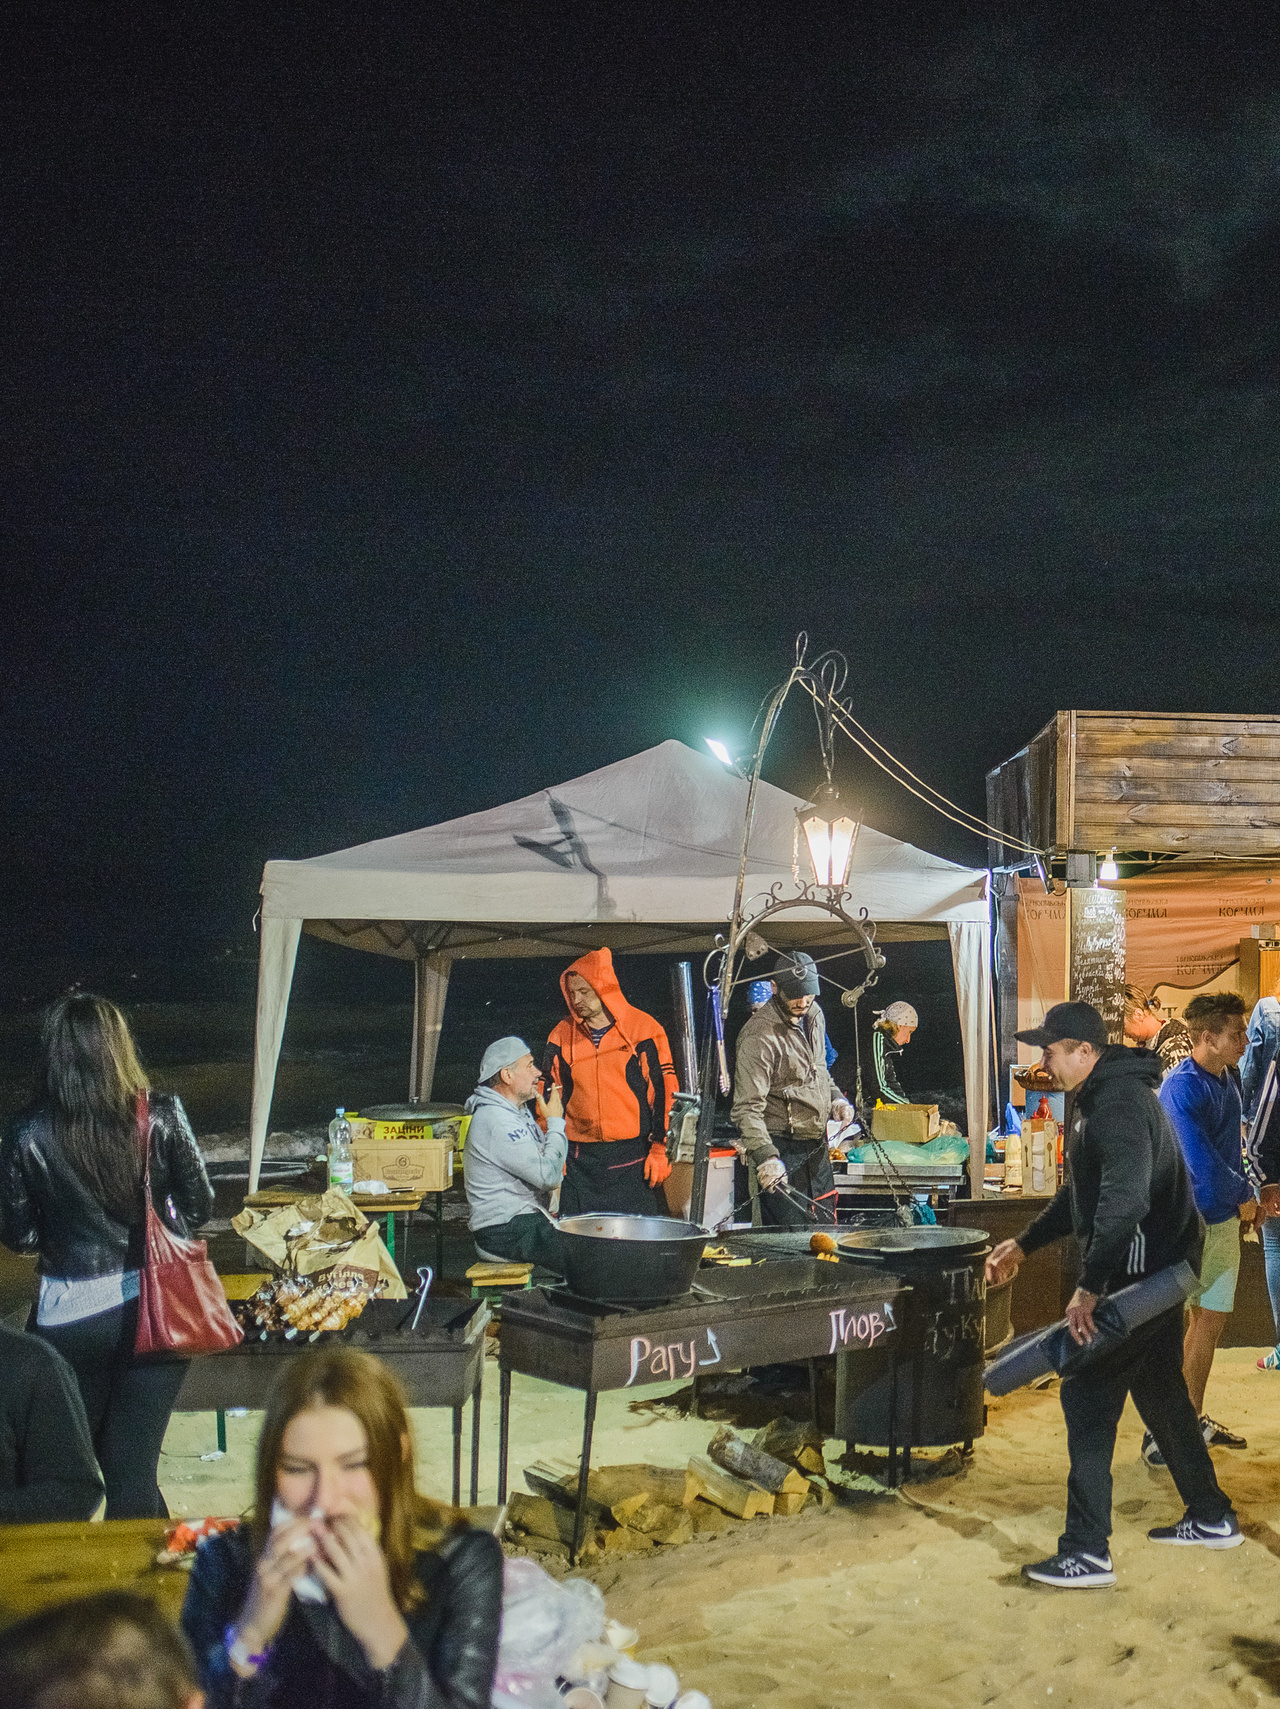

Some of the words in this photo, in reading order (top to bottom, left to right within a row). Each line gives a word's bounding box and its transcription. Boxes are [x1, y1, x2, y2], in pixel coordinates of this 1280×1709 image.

[383, 1125, 425, 1135] ЗАЦІНИ
[829, 1308, 885, 1355] Плов
[623, 1337, 696, 1388] Рагу
